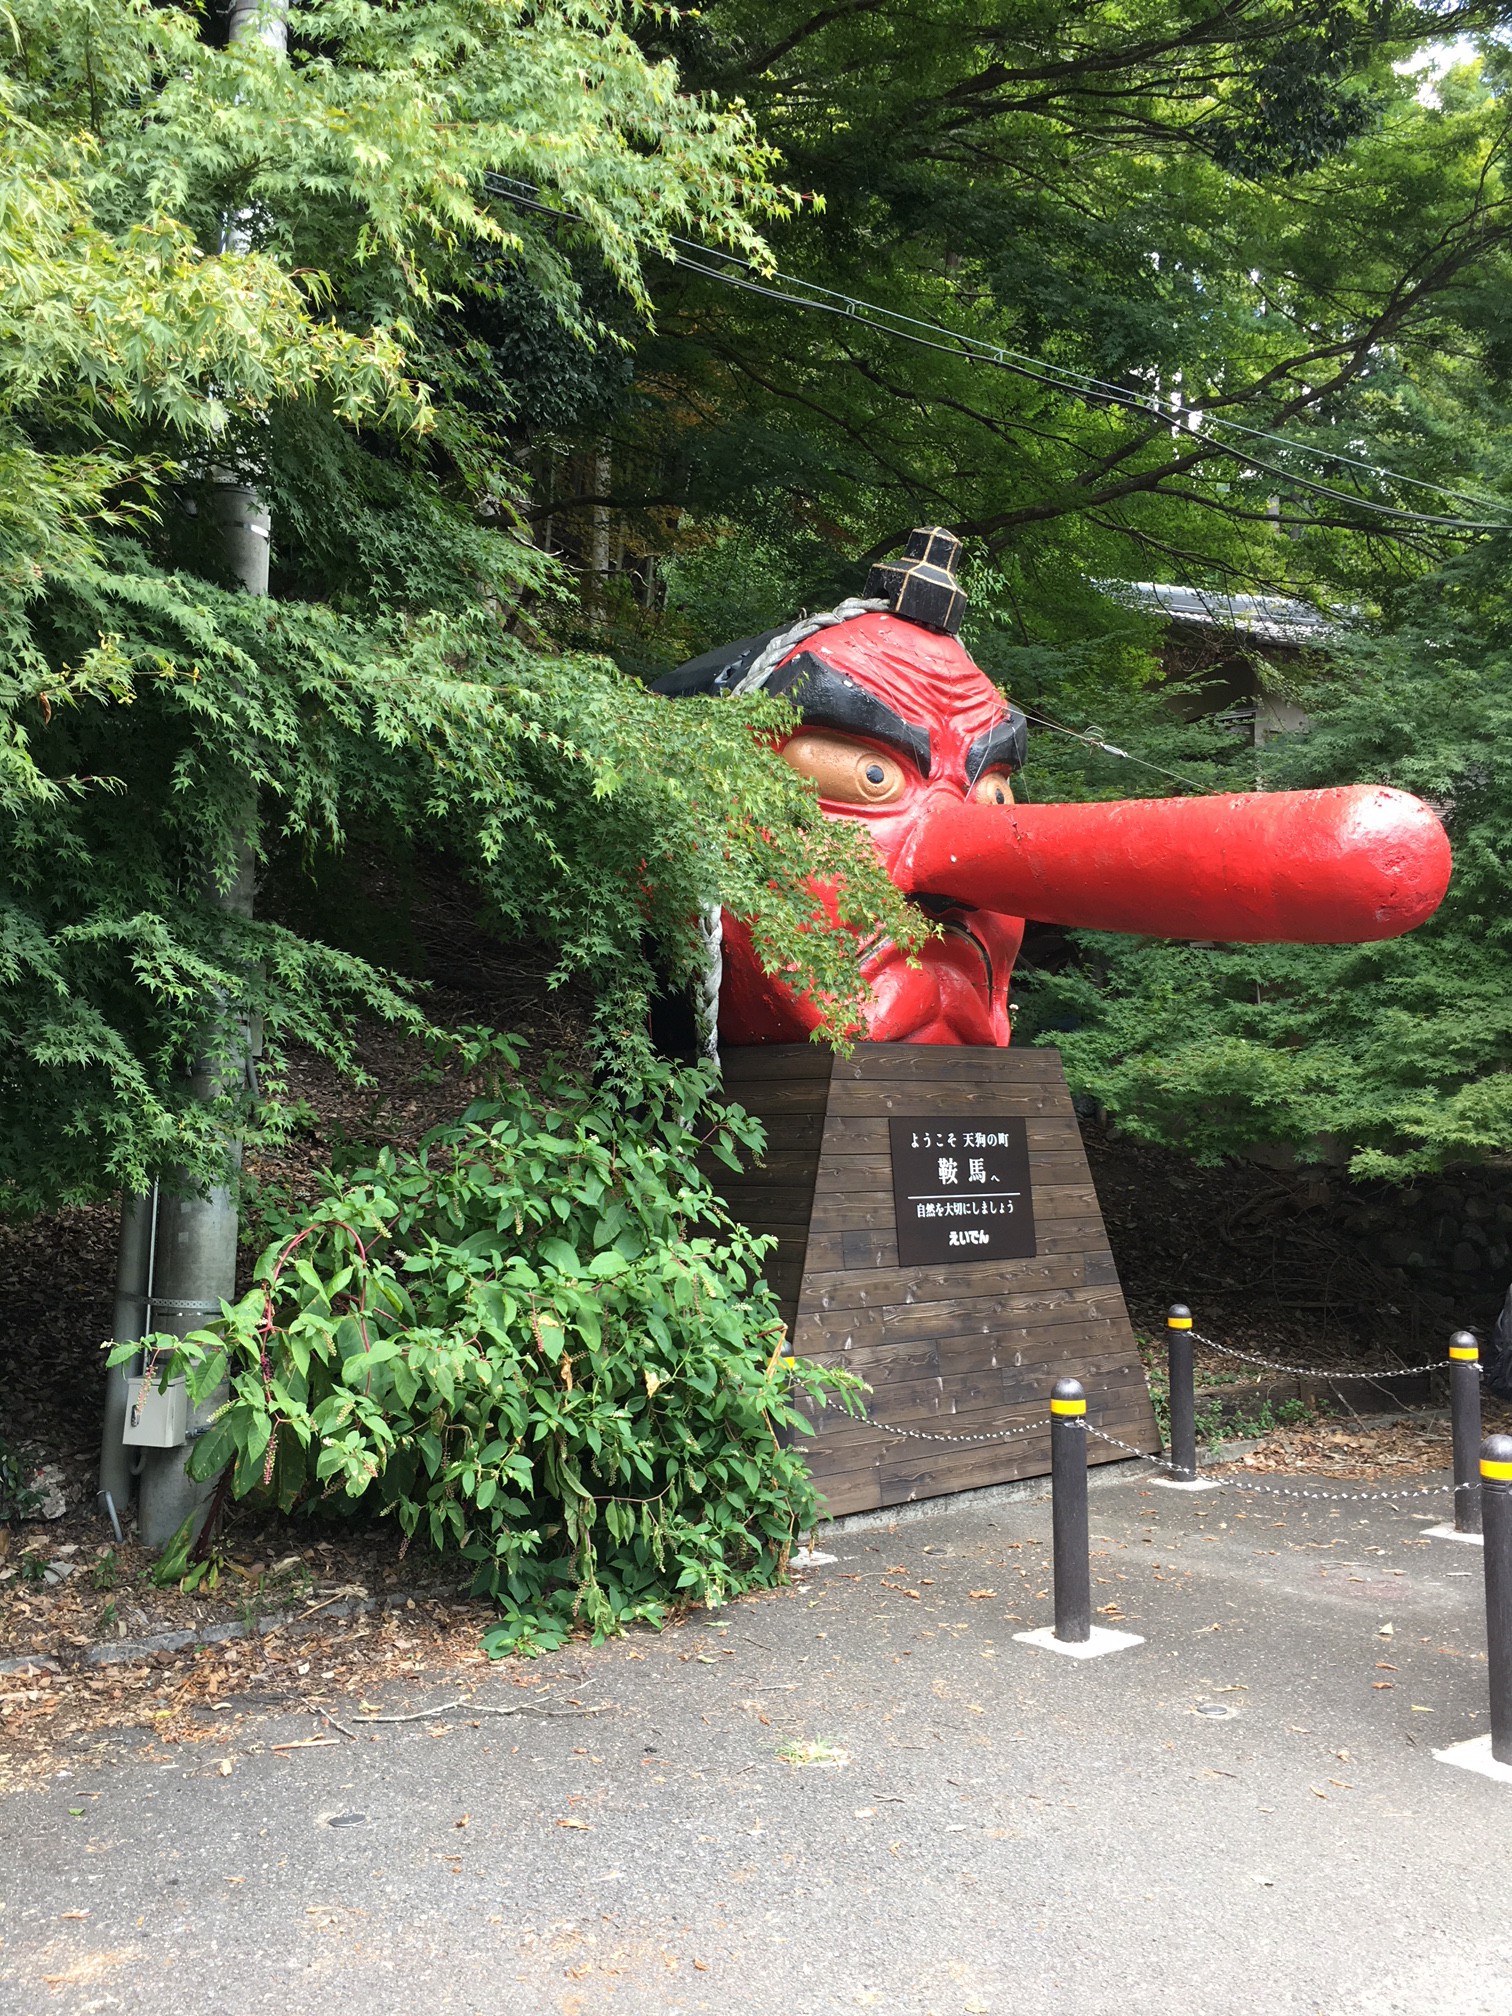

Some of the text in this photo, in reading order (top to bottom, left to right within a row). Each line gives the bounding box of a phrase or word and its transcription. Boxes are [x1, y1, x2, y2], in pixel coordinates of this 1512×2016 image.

[910, 1132, 957, 1149] ようこそ
[916, 1199, 1014, 1219] 自然を大切にしましょう
[948, 1229, 990, 1247] えいでん
